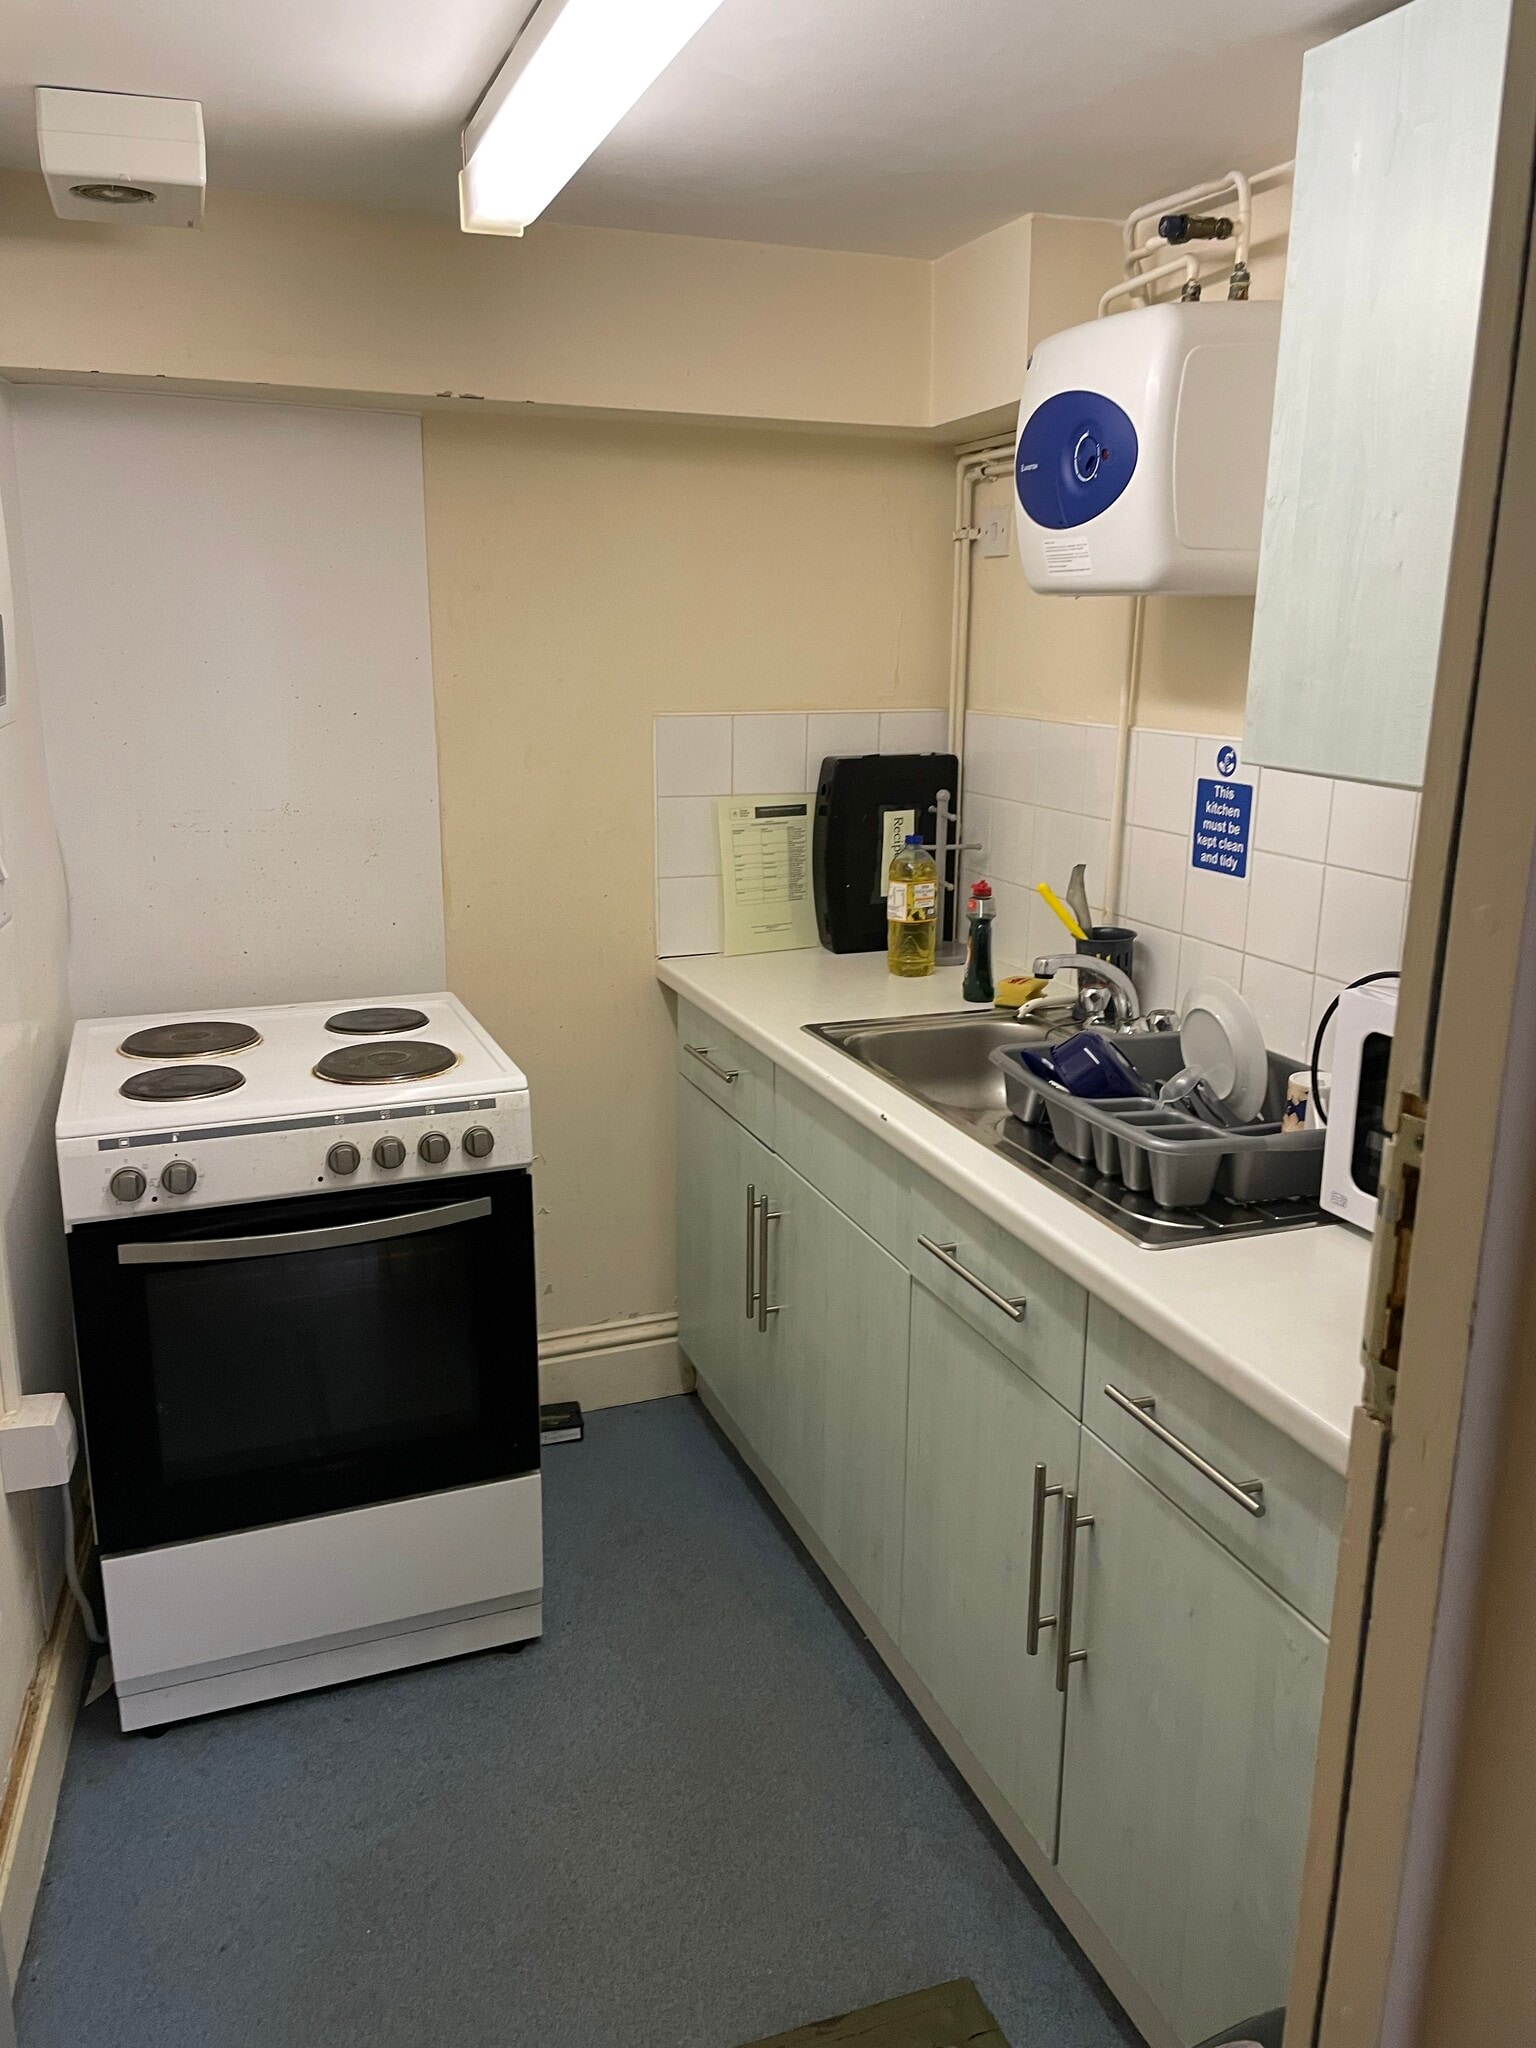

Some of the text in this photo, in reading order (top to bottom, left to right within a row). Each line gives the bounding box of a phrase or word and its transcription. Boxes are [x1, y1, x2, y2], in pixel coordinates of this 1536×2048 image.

[1214, 785, 1235, 800] This
[1205, 800, 1241, 818] kitchen
[1203, 820, 1240, 835] must be
[1197, 832, 1244, 853] kept clean
[1200, 852, 1238, 871] and tidy
